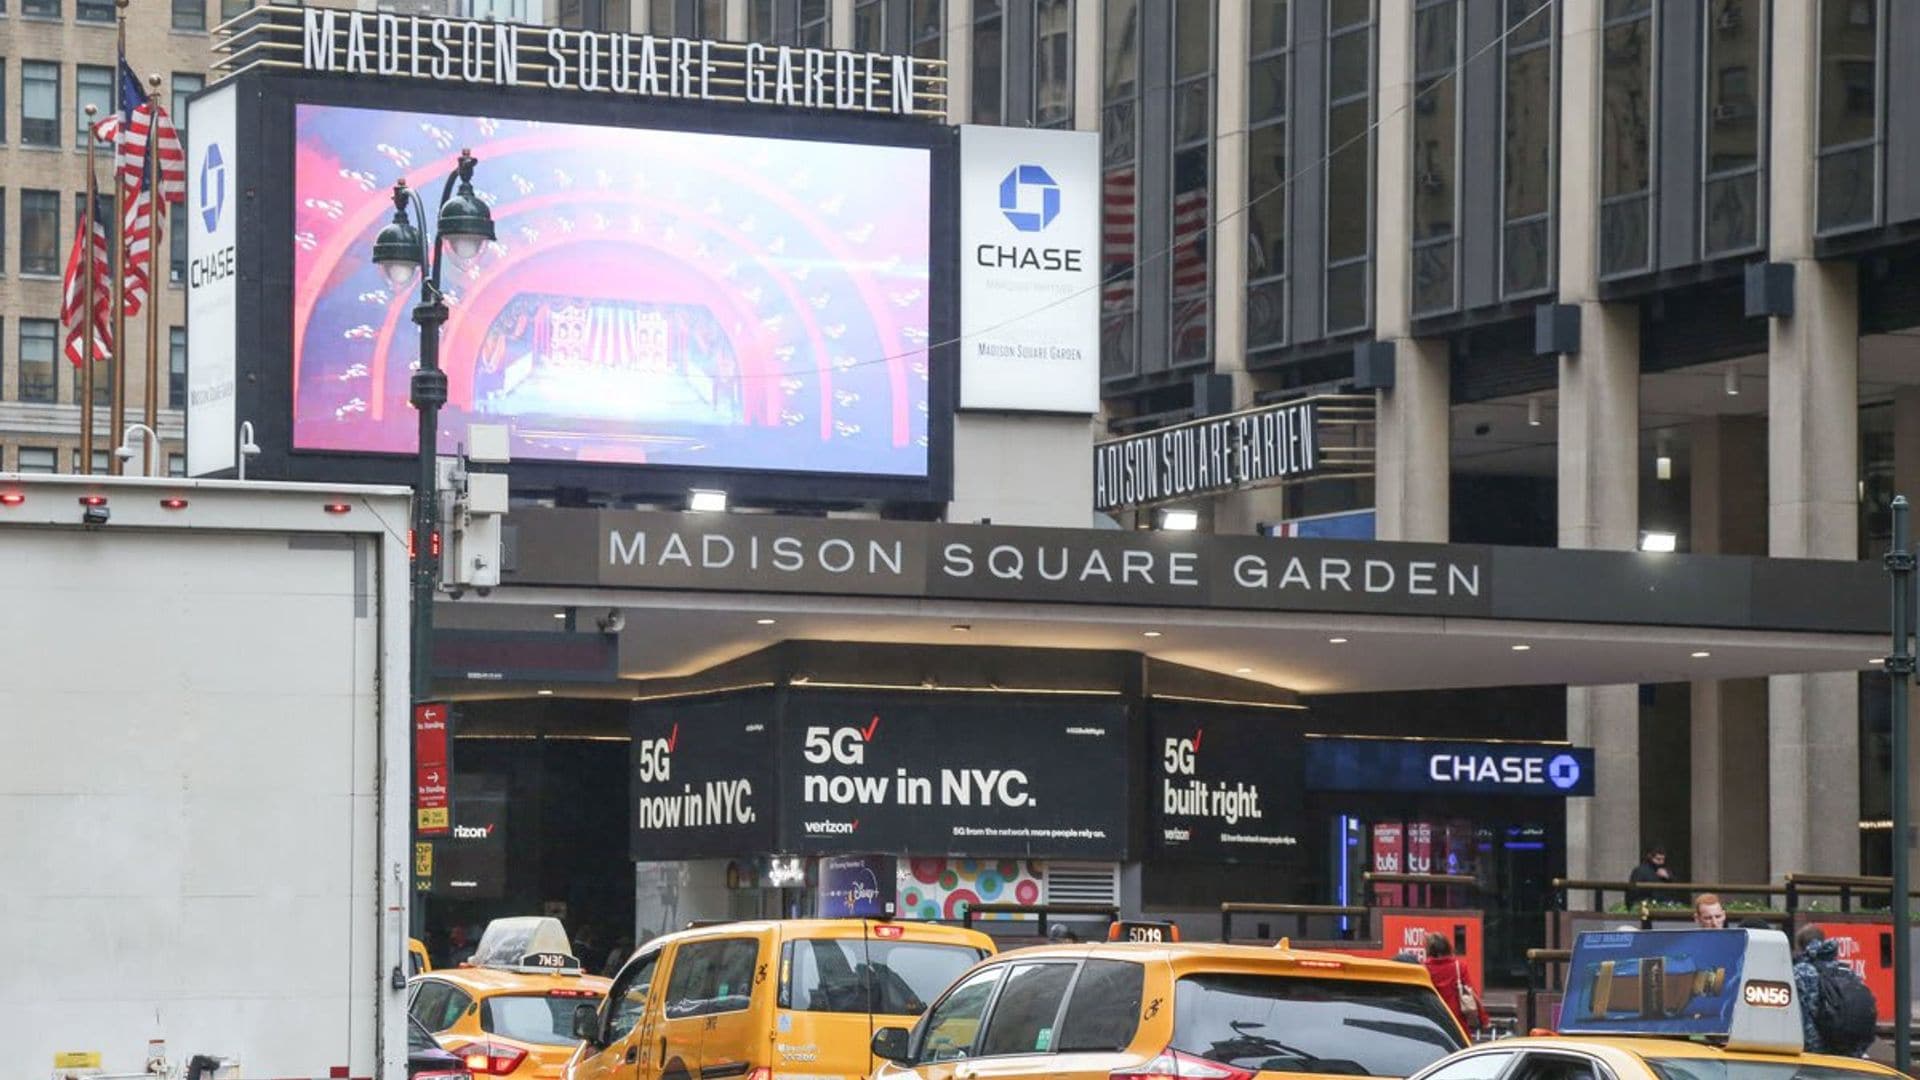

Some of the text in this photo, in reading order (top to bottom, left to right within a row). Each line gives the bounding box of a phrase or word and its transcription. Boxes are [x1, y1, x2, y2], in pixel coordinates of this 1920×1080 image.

[303, 7, 914, 115] MADISON SQUARE GARDEN
[191, 245, 235, 289] CHASE
[977, 244, 1082, 272] CHASE
[1097, 403, 1313, 508] ADISON SQUARE GARDEN
[608, 530, 1480, 597] MADISON SQUARE GARDEN
[640, 738, 670, 783] 5G
[803, 726, 864, 765] 5G
[1164, 738, 1195, 774] 5G
[1430, 754, 1545, 784] CHASE
[639, 778, 756, 829] now in NYC.
[804, 768, 1037, 807] now in NYC.
[1163, 778, 1262, 825] built right.
[454, 825, 488, 839] rizon
[804, 820, 854, 834] verizon
[1051, 828, 1078, 838] people
[1376, 852, 1398, 871] tubi
[1129, 926, 1162, 944] 5D19
[1404, 927, 1425, 946] NOT
[1745, 985, 1790, 1005] 9N56
